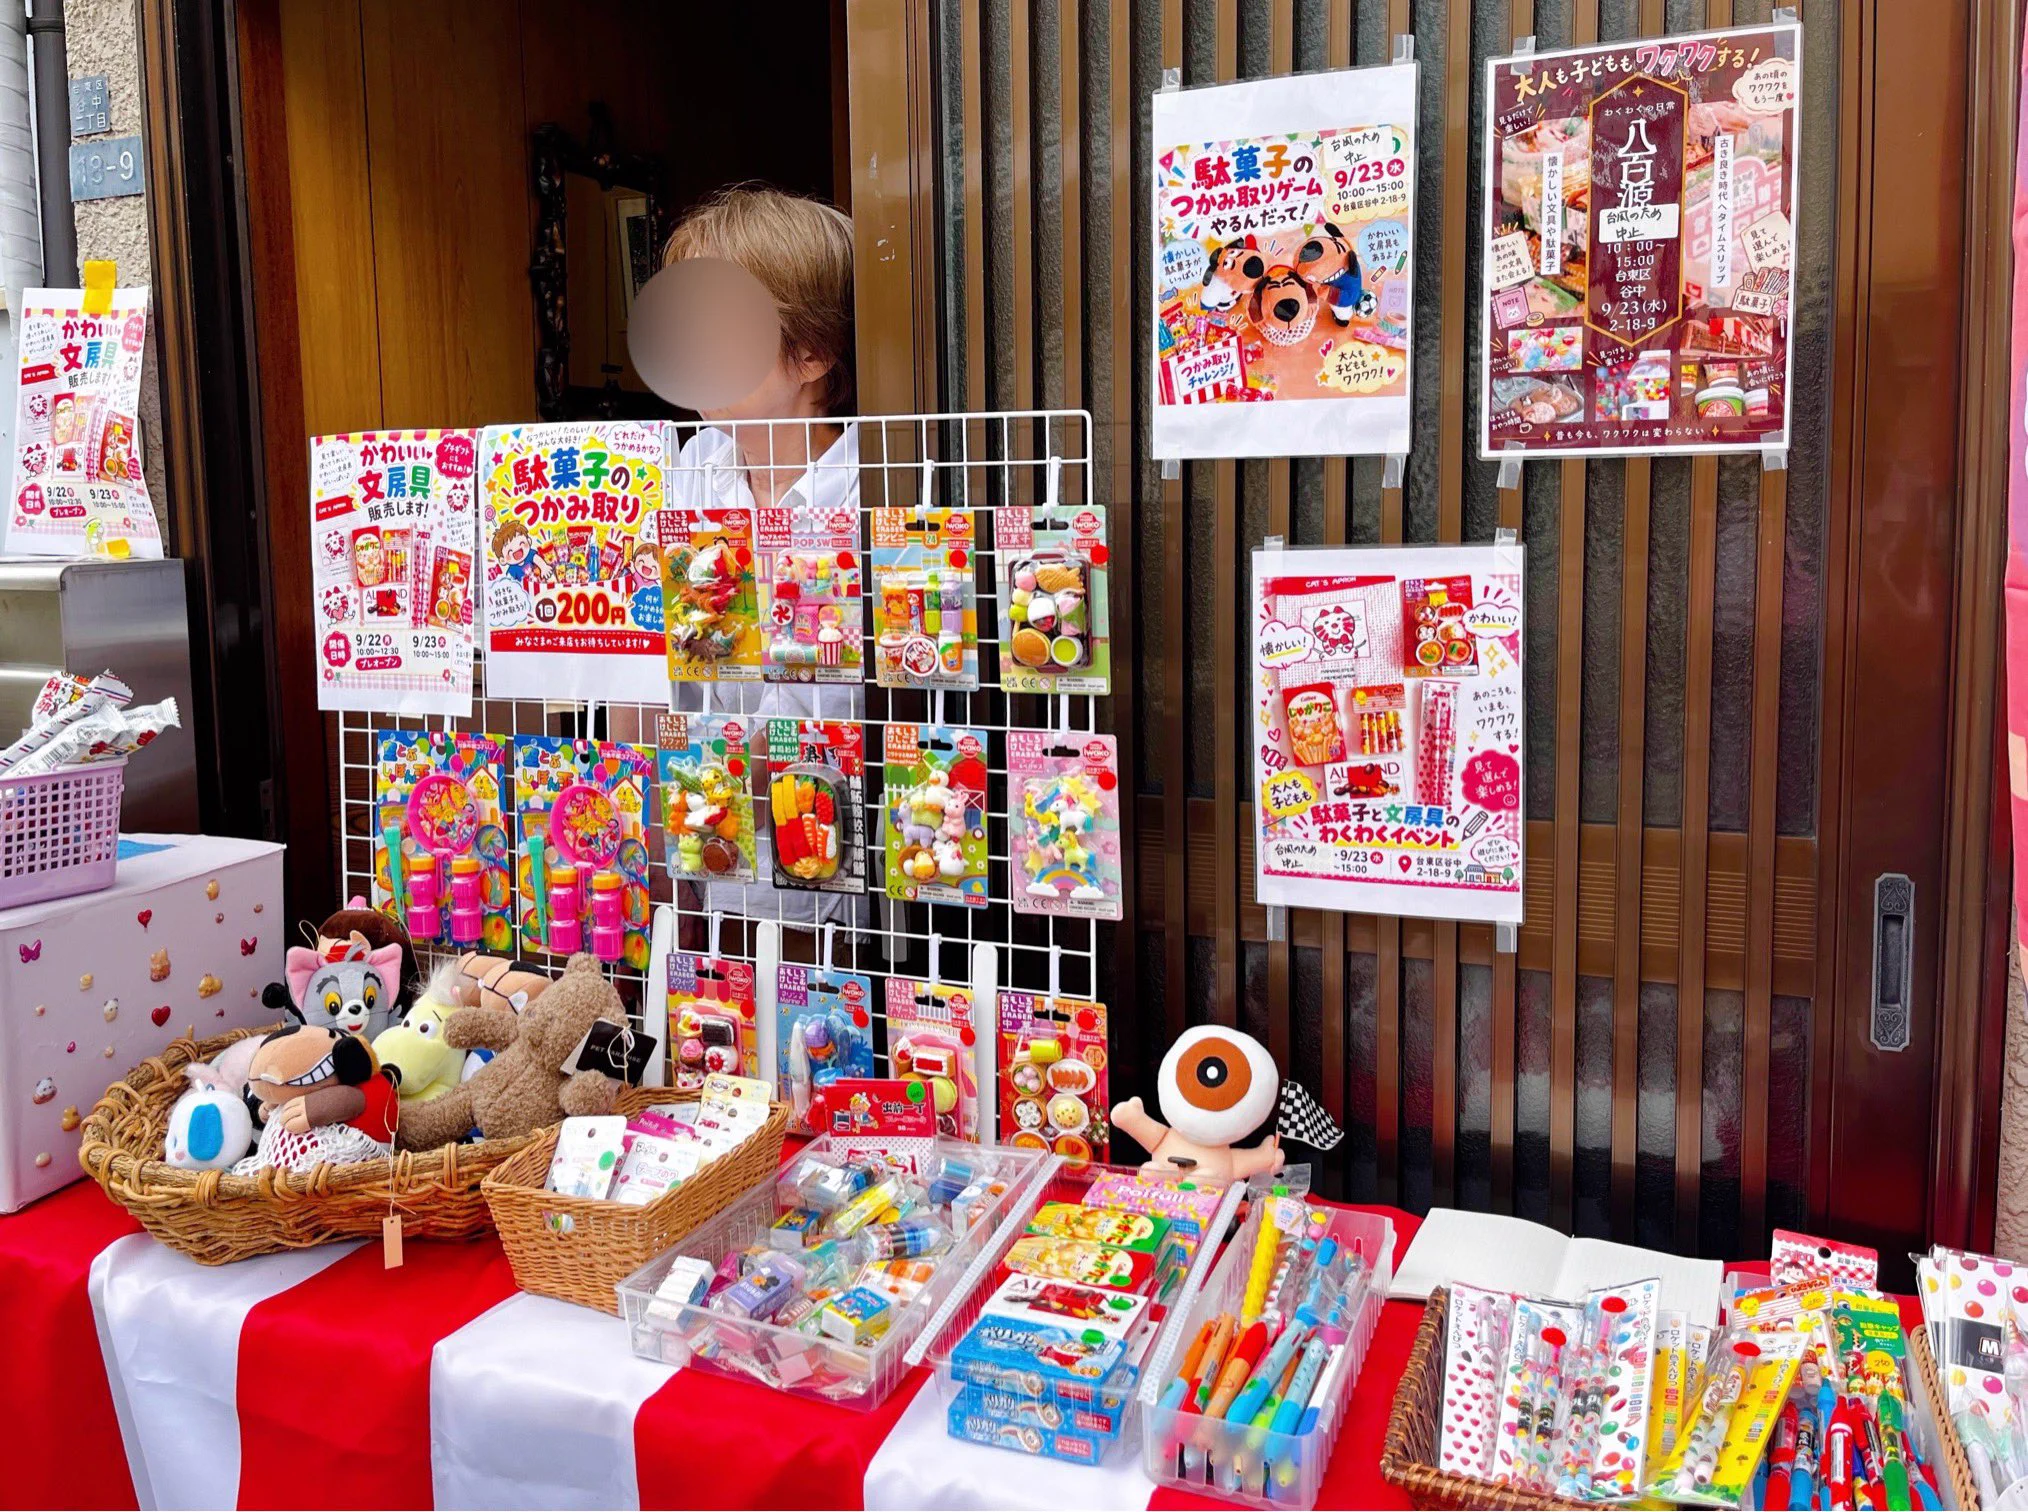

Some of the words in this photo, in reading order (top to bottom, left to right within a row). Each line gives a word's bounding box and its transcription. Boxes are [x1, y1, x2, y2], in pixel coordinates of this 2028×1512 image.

[1754, 69, 1788, 80] あの頃の
[1749, 82, 1787, 93] ワクワクを
[1754, 93, 1784, 104] もう一度
[75, 112, 106, 131] 二丁目
[1499, 106, 1533, 125] 見るだけで
[1505, 117, 1531, 133] 楽しい！
[1330, 133, 1380, 152] 台風のため
[1344, 151, 1367, 165] 中止
[1617, 117, 1657, 209] 八百源
[1192, 144, 1313, 190] 駄菓子の
[1334, 161, 1384, 189] 9/23
[1387, 159, 1404, 176] 水
[1171, 177, 1322, 217] つかみ取りゲーム
[1343, 198, 1379, 212] 台東区谷中
[1381, 193, 1407, 205] 2-18-9
[1545, 156, 1558, 272] 懐かしい文具や駄菓子
[1607, 207, 1662, 224] 台風のため
[1716, 138, 1729, 284] 古き良き時代へタイムスリップ
[1211, 203, 1309, 236] やるんだって！
[1367, 229, 1399, 240] かわいい
[1616, 227, 1644, 240] 中止
[1751, 228, 1767, 241] 見て
[1368, 240, 1399, 252] 文房具も
[1753, 233, 1778, 251] 選んで
[1162, 247, 1200, 264] 懐かしい
[1372, 251, 1398, 262] あるよ！
[1617, 256, 1654, 267] 15:00
[1164, 257, 1202, 275] 駄菓子が
[1169, 268, 1203, 284] いっぱい！
[1615, 270, 1651, 282] 台東区
[1620, 285, 1646, 298] 谷中
[1502, 298, 1519, 307] NOTE
[1740, 295, 1769, 309] 駄菓子
[62, 319, 119, 340] かわいい
[1610, 317, 1656, 332] 2-18-9
[60, 341, 118, 370] 文房具
[1338, 350, 1364, 362] 大人も
[1600, 347, 1626, 359] 見つける
[1181, 352, 1231, 377] つかみ取り
[1335, 361, 1368, 375] 子どもも
[68, 371, 111, 389] 販売します！
[1187, 364, 1235, 387] チャレンジ！
[1342, 367, 1384, 385] ワクワク！
[613, 430, 645, 441] どれだけ
[360, 442, 427, 467] かわいい
[443, 443, 470, 456] プチギフト
[613, 442, 661, 456] つかめるかな？
[449, 455, 459, 463] にも
[512, 446, 631, 497] 駄菓子の
[358, 465, 431, 504] 文房具
[47, 487, 66, 497] 9/22
[90, 489, 111, 500] 9/23
[52, 507, 84, 516] プレオープン
[368, 501, 429, 522] 販売します！
[514, 491, 640, 526] つかみ取り
[365, 588, 408, 600] ALND
[494, 586, 512, 596] 好きな
[645, 595, 659, 603] 何が
[538, 604, 554, 616] 1回
[557, 592, 626, 625] 200円
[1469, 613, 1517, 626] かわいい！
[328, 639, 345, 650] 開催
[355, 634, 381, 647] 9/22
[413, 636, 437, 648] 9/23
[1260, 637, 1306, 656] 懐かしい！
[330, 651, 346, 661] 日時
[359, 657, 398, 669] プレオープン
[1288, 701, 1332, 717] じゃがりこ
[1476, 712, 1515, 729] ワクワク
[1493, 728, 1518, 741] する！
[1330, 761, 1399, 779] ALND
[1474, 761, 1493, 774] 見て
[1482, 768, 1508, 783] 選んで
[1270, 779, 1301, 795] 大人も
[1475, 781, 1517, 799] 楽しめる！
[1273, 790, 1311, 809] 子どもも
[1311, 802, 1460, 828] 駄菓子と文房具の
[1319, 824, 1455, 848] わくわくイベント
[1282, 858, 1303, 868] 中止
[1340, 850, 1368, 862] 9/23
[1416, 856, 1462, 868] 台東区谷中
[1416, 868, 1451, 878] 2-18-9
